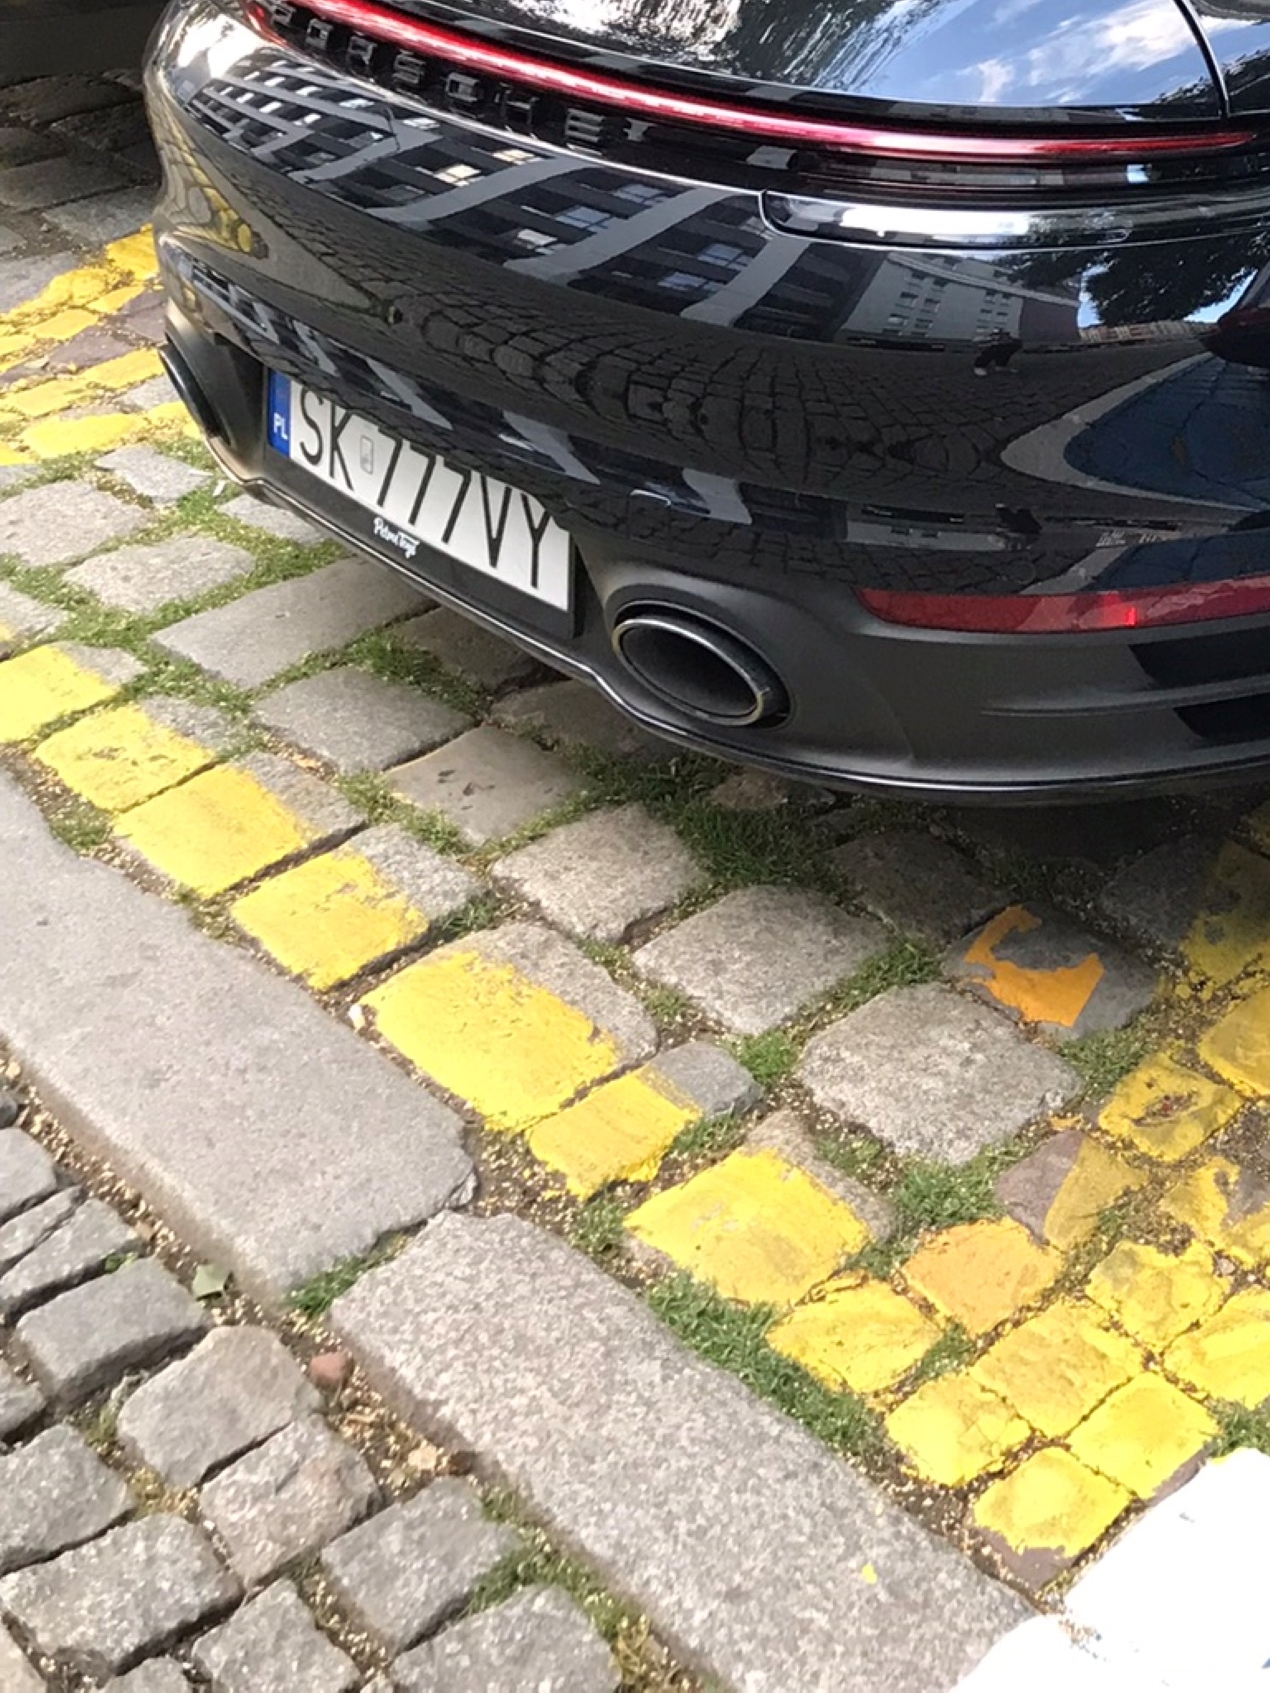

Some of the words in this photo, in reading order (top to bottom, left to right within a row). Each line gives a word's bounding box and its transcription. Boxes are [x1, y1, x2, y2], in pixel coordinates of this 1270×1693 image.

[273, 411, 288, 442] PL
[300, 387, 354, 492] SK
[377, 427, 552, 590] 777VY
